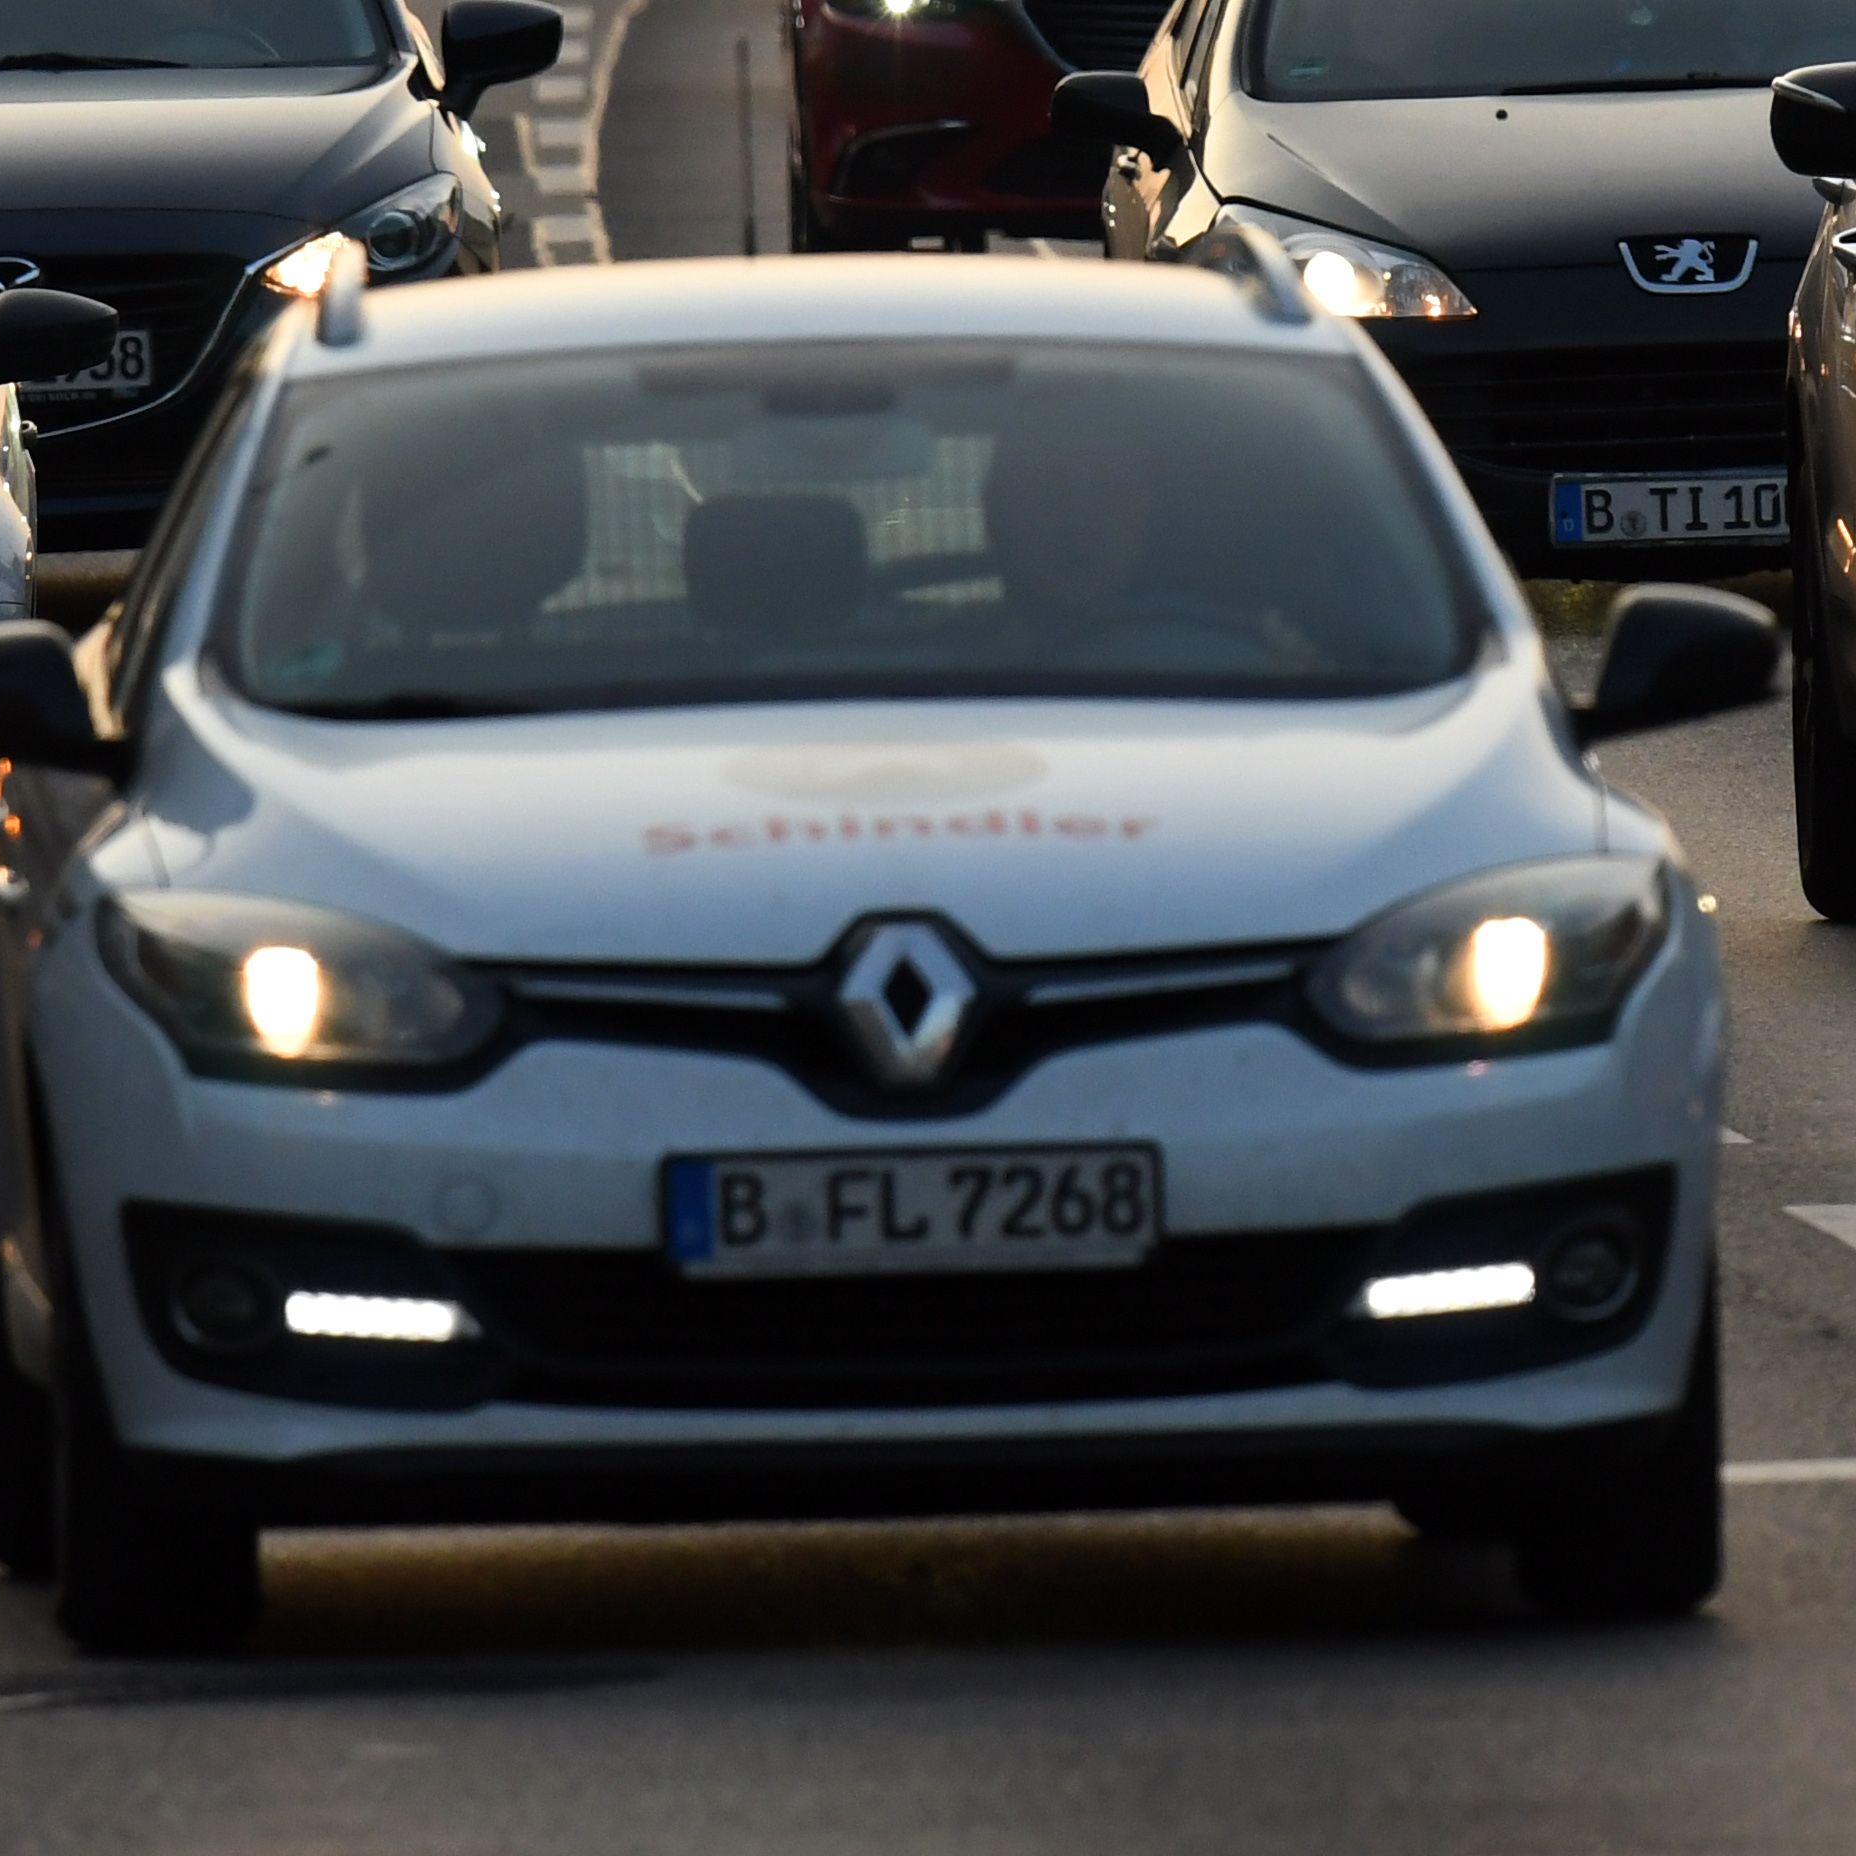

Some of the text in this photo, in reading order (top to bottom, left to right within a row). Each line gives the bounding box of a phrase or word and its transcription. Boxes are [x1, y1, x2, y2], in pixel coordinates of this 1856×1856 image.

[1584, 489, 1614, 534] B
[1649, 486, 1708, 532] TI
[1723, 483, 1790, 530] 10
[644, 809, 1157, 855] Schindler
[718, 1160, 1147, 1248] B FL 7268
